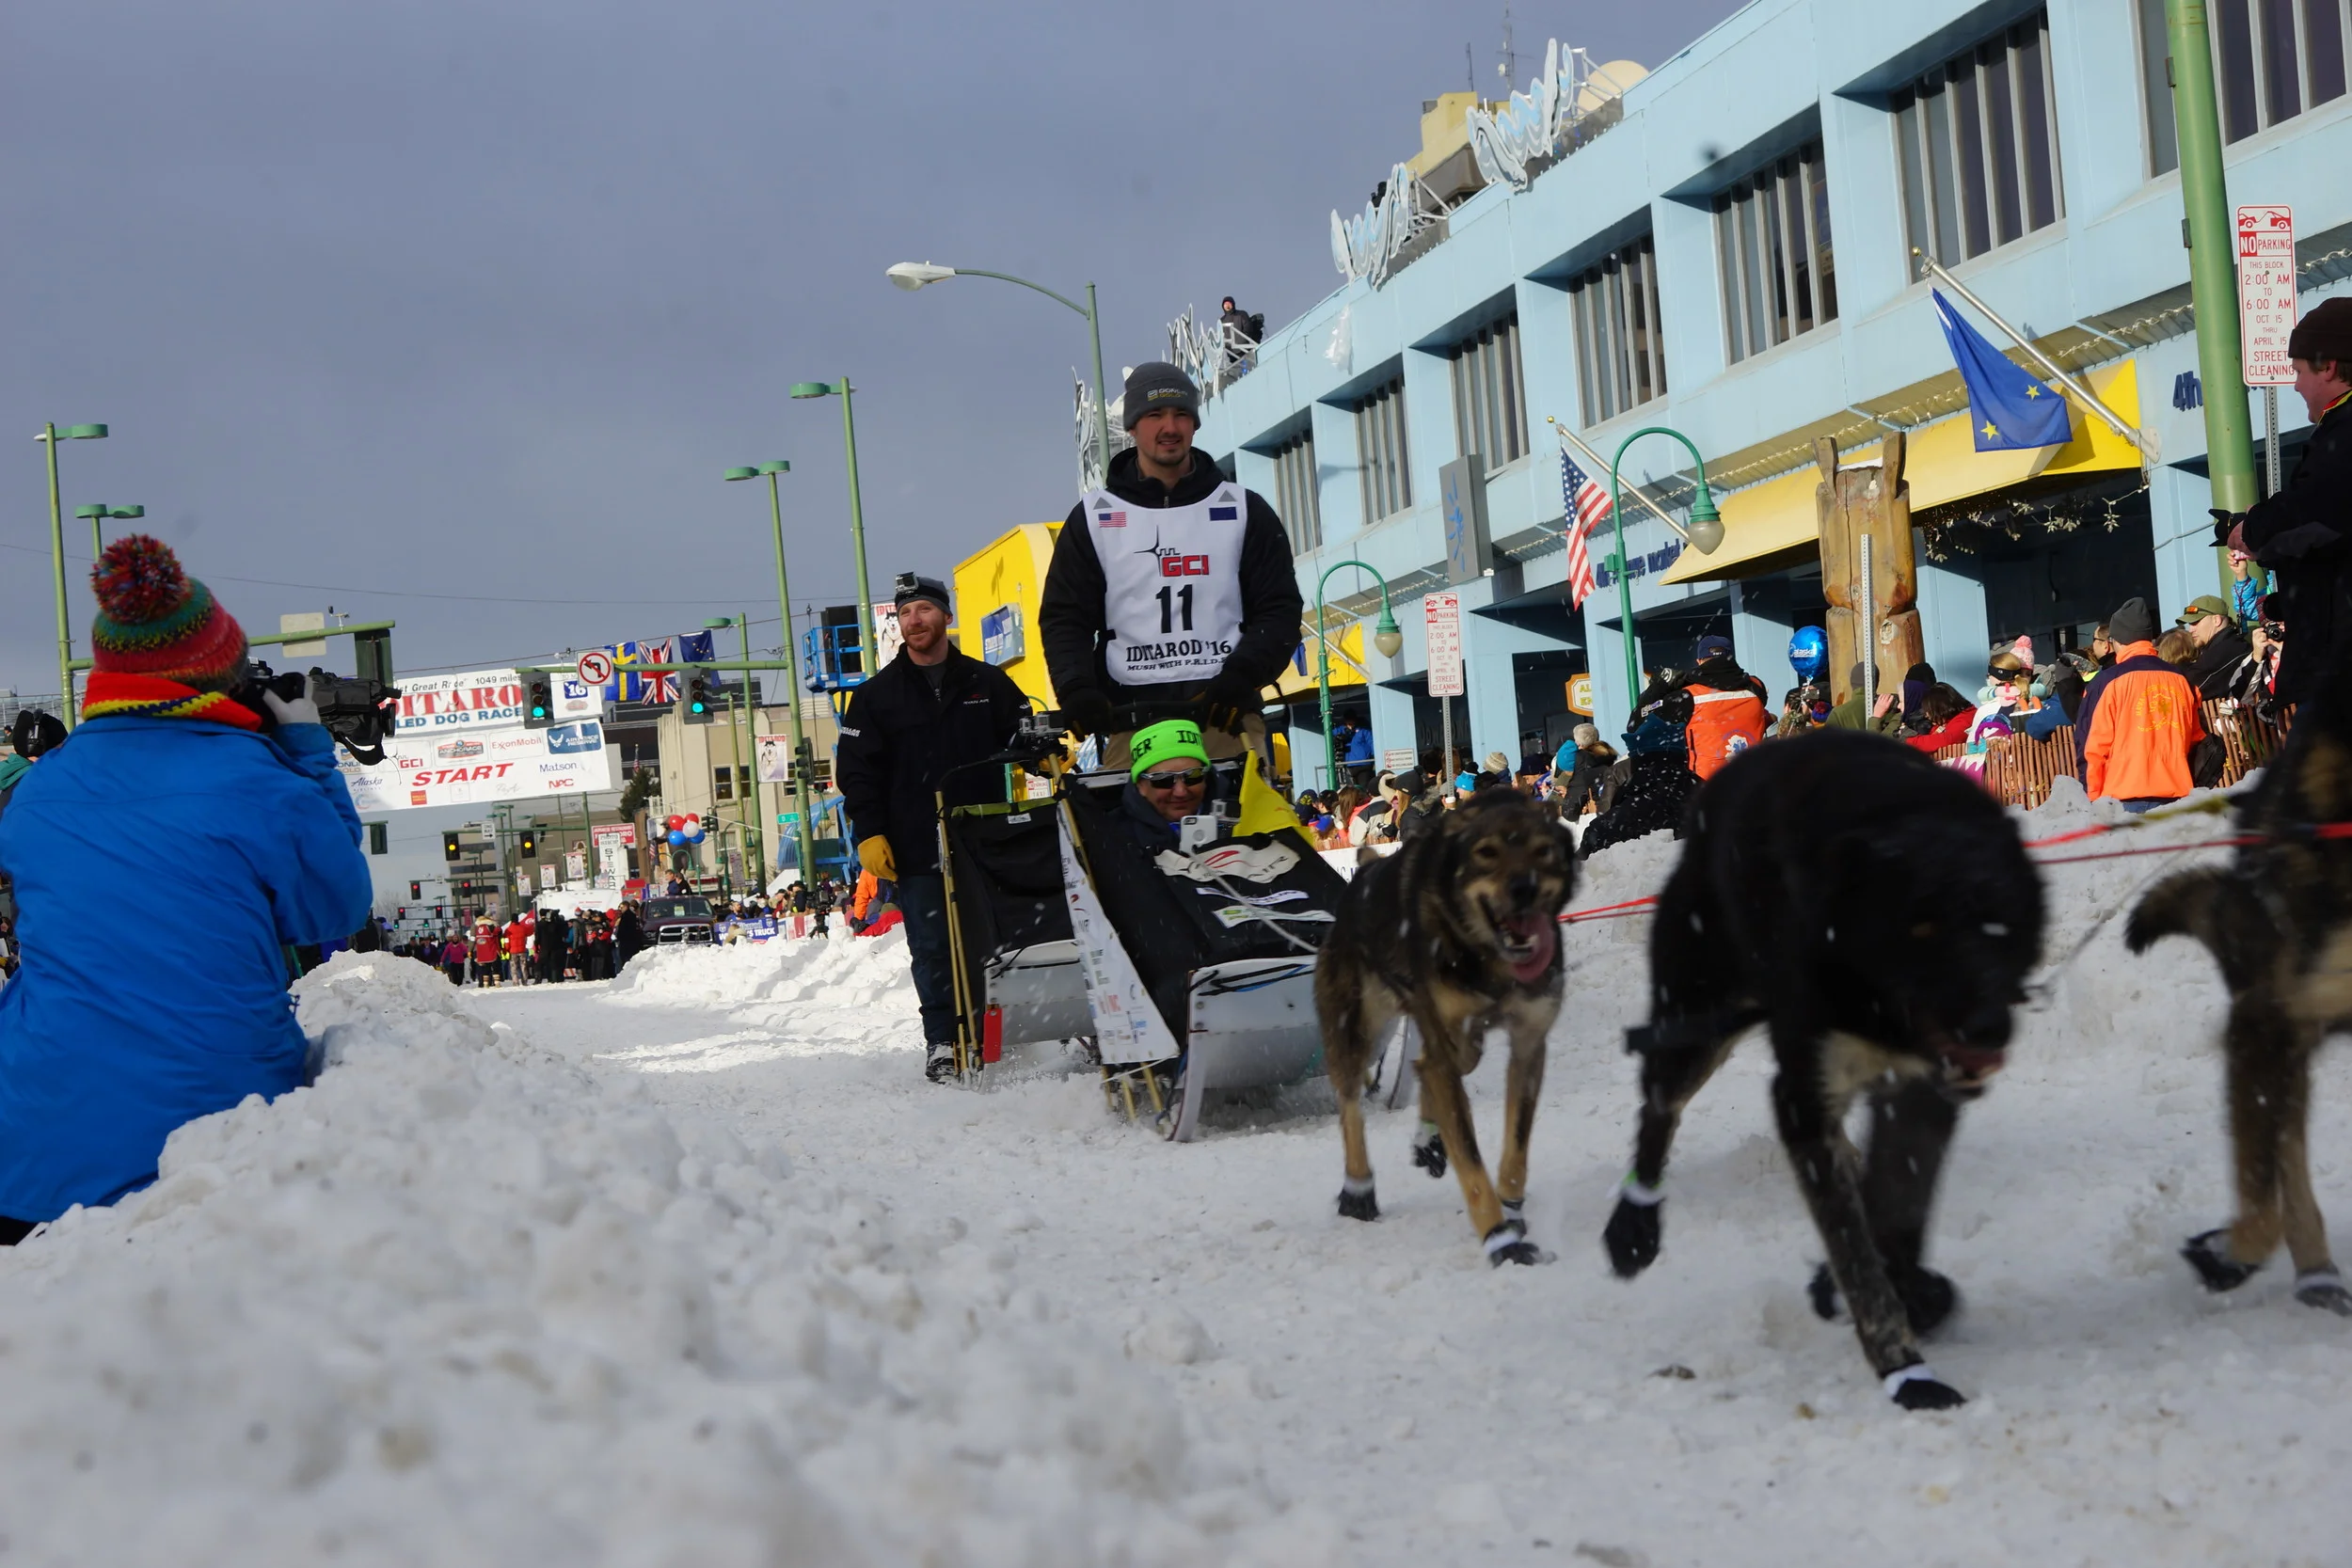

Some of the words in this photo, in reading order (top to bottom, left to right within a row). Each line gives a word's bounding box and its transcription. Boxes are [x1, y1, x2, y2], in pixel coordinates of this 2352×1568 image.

[2240, 236, 2256, 253] NO
[2258, 238, 2291, 250] PARKING
[2277, 274, 2290, 284] AM
[2278, 298, 2292, 309] AM
[2253, 337, 2274, 345] APRIL
[2280, 337, 2287, 345] 15
[2253, 350, 2288, 362] STREET
[2249, 364, 2295, 376] CLEANING
[1162, 555, 1209, 577] GCI
[1155, 584, 1193, 633] 11
[1426, 611, 1437, 621] NO
[1125, 639, 1202, 662] IDITAROD
[1159, 660, 1182, 669] WITH
[413, 682, 437, 692] Great
[435, 712, 470, 725] DOG
[478, 707, 523, 721] RACE
[492, 736, 542, 750] ExxonMobil
[400, 758, 423, 768] GCI
[539, 762, 577, 772] Matson
[412, 763, 514, 786] START
[351, 777, 383, 786] Alaska
[755, 928, 775, 937] TRUCK
